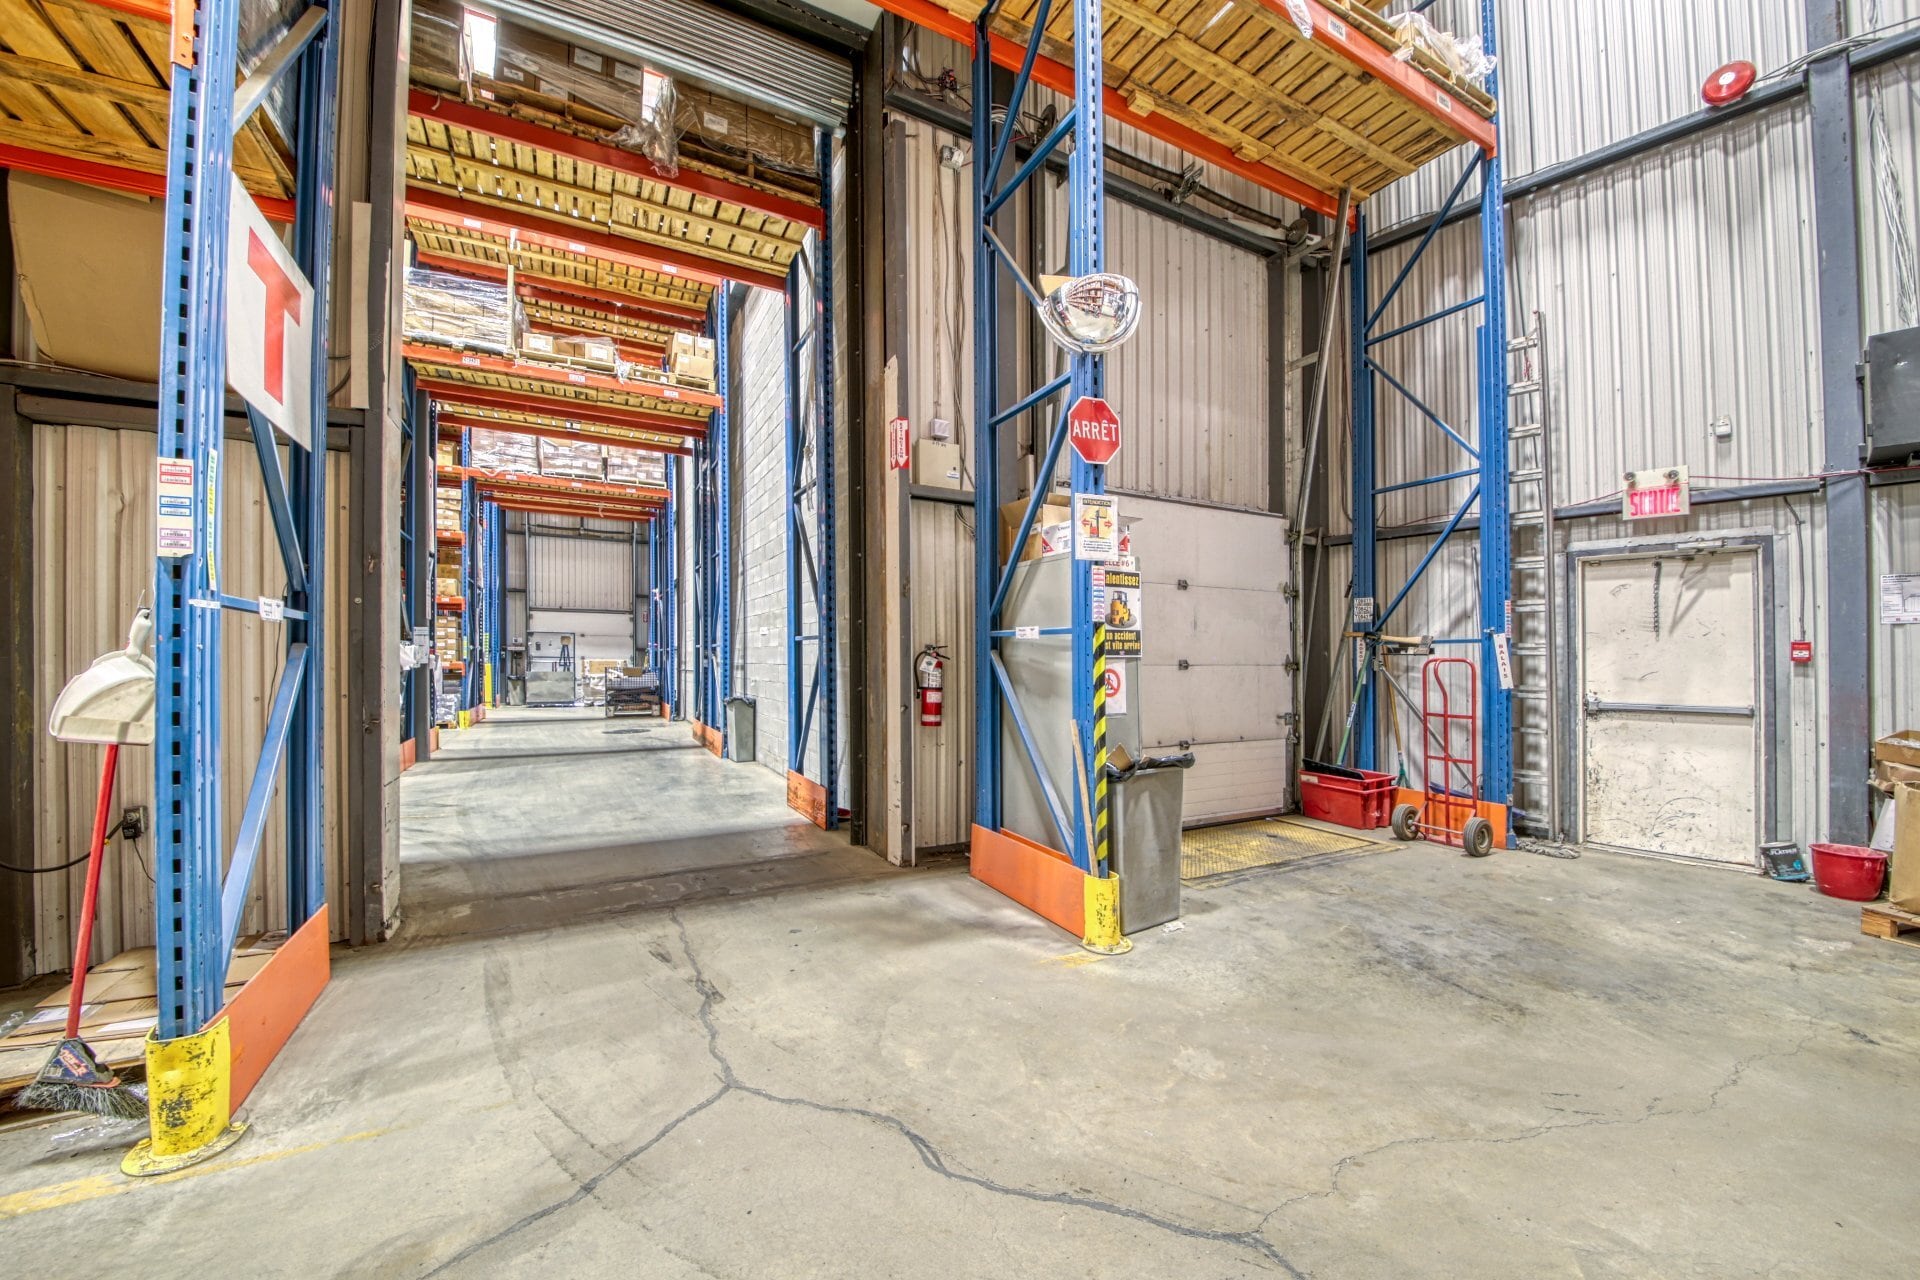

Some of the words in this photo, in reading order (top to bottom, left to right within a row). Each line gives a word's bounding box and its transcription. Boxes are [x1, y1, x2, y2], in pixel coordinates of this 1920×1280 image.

[248, 227, 302, 406] T
[1072, 419, 1118, 442] ARRÊT
[1630, 487, 1681, 516] SORTIE
[1105, 572, 1139, 586] alentissez
[1114, 631, 1137, 641] accident
